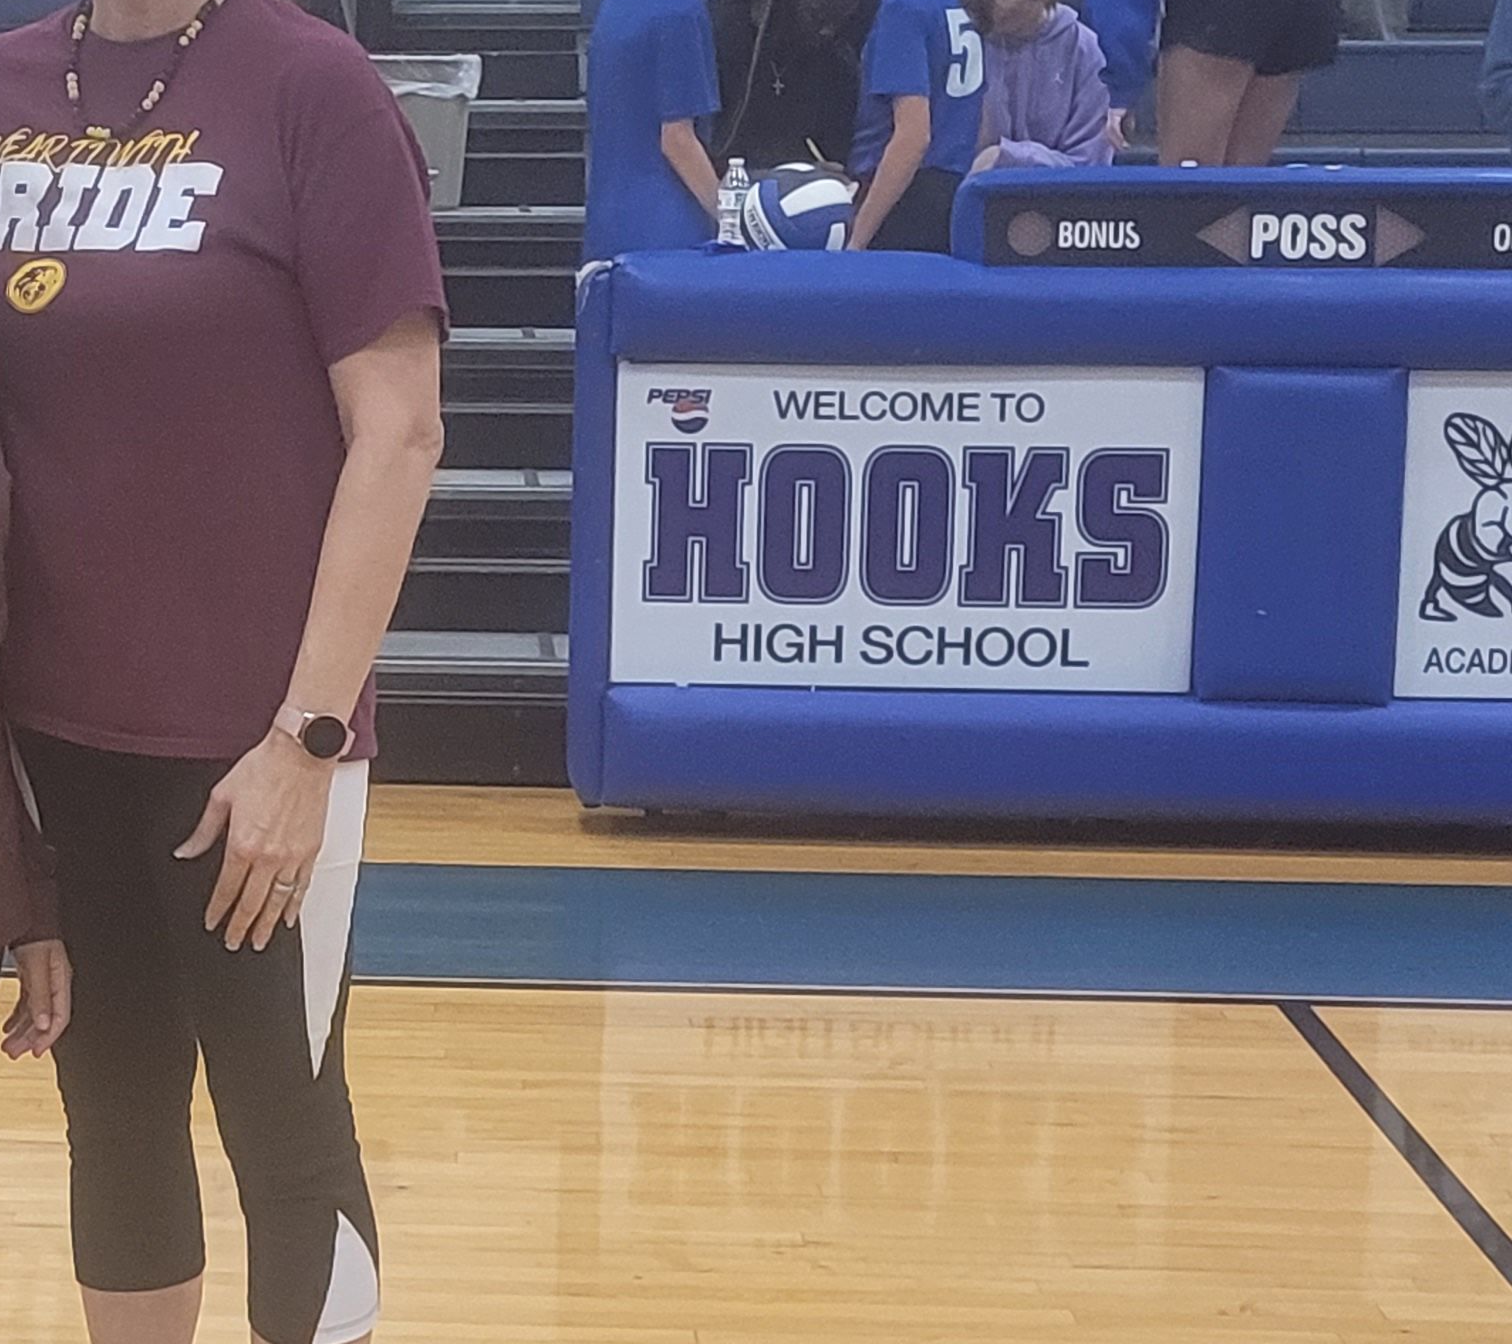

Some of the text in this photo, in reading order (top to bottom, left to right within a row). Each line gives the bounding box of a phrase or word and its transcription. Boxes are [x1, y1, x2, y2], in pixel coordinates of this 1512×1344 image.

[944, 7, 984, 98] 5
[106, 128, 201, 170] WITH
[1056, 219, 1143, 250] BONUS
[1250, 213, 1369, 261] POSS
[646, 387, 713, 405] PEPSI
[772, 388, 1047, 424] WELCOME TO
[641, 441, 1172, 611] HOOKS
[712, 622, 1091, 669] HIGH SCHOOL
[1423, 646, 1512, 675] ACAD
